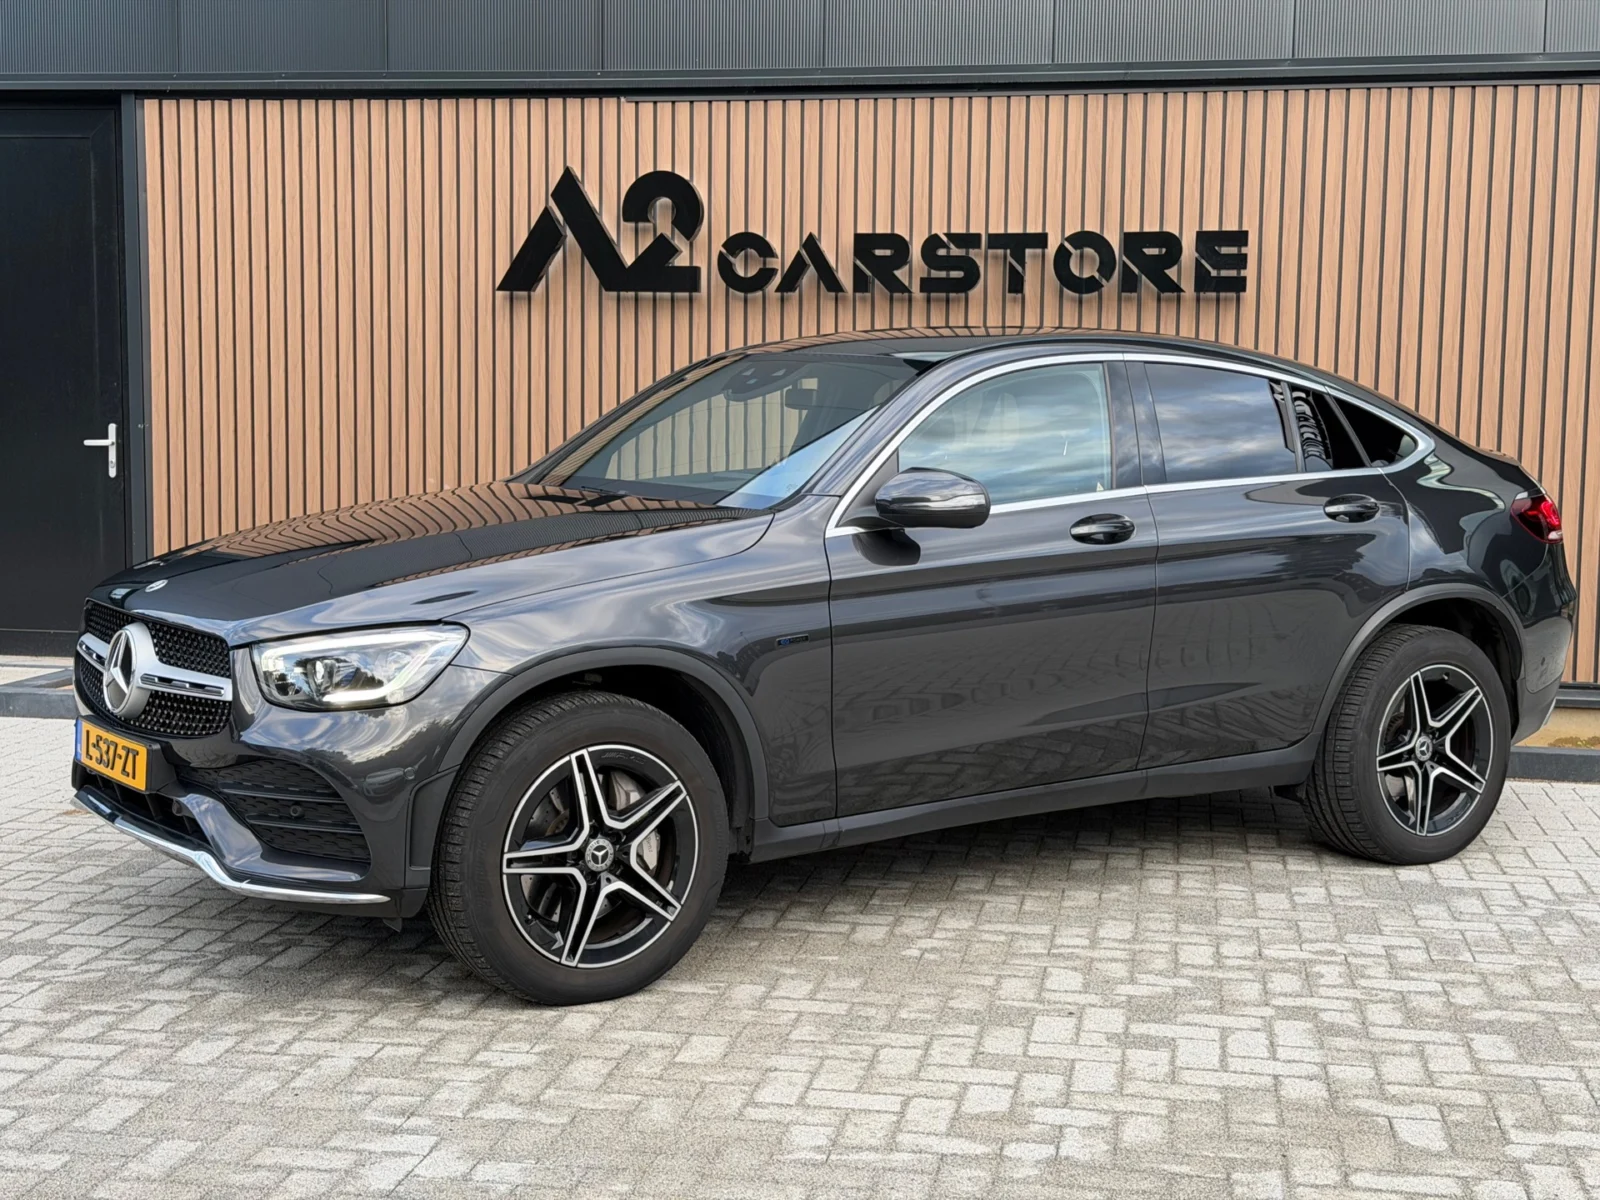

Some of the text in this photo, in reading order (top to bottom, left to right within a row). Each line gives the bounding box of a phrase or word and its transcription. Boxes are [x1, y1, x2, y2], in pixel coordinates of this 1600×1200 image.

[496, 166, 1249, 294] A2 CARSTORE
[85, 729, 139, 780] L-537-ZT
